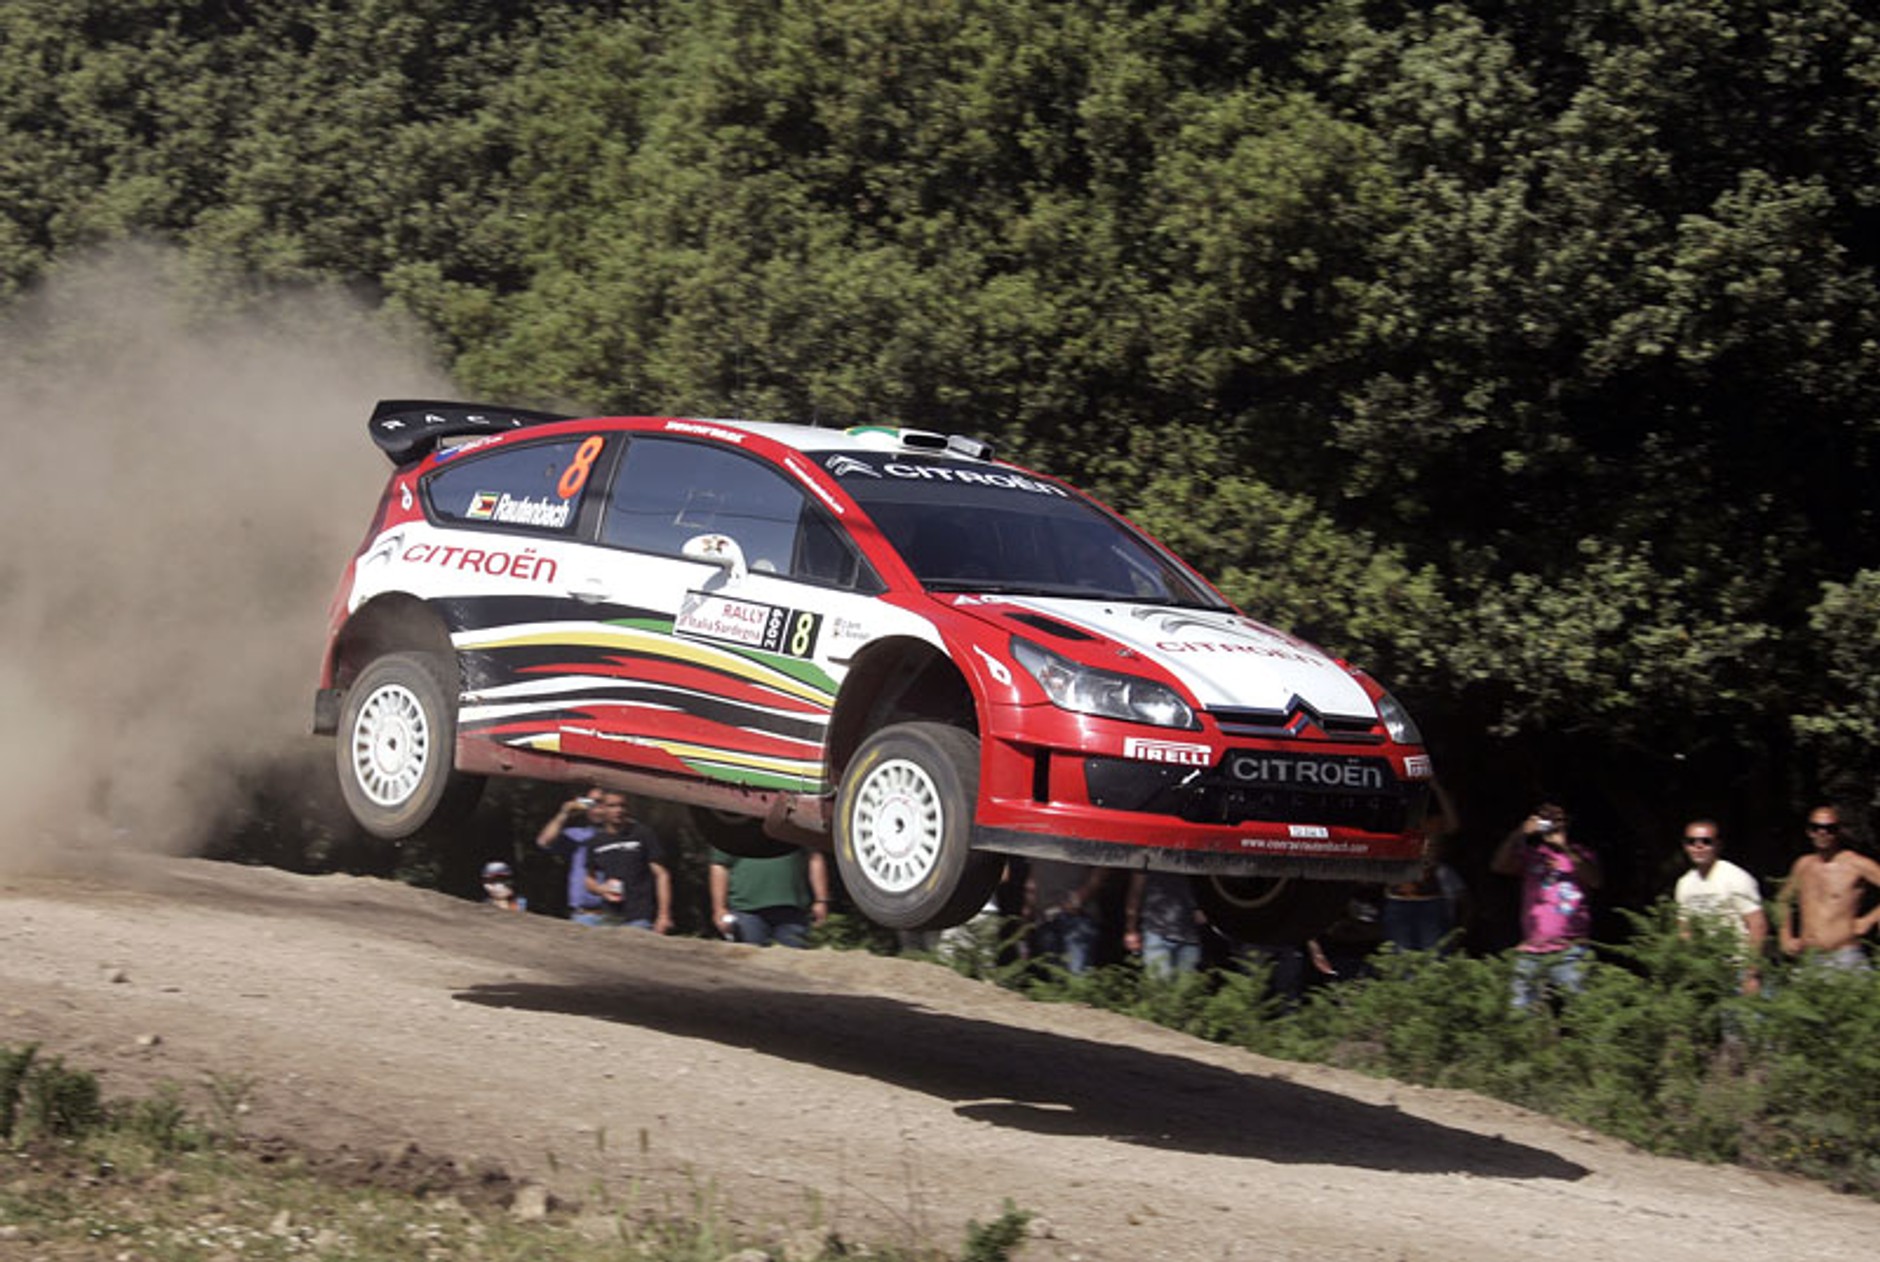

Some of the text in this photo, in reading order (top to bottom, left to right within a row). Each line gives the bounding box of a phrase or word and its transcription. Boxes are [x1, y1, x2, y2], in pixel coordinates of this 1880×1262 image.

[557, 435, 604, 499] 8
[722, 603, 766, 624] RALLY
[791, 612, 815, 657] 8
[1123, 736, 1212, 767] PIRELLI
